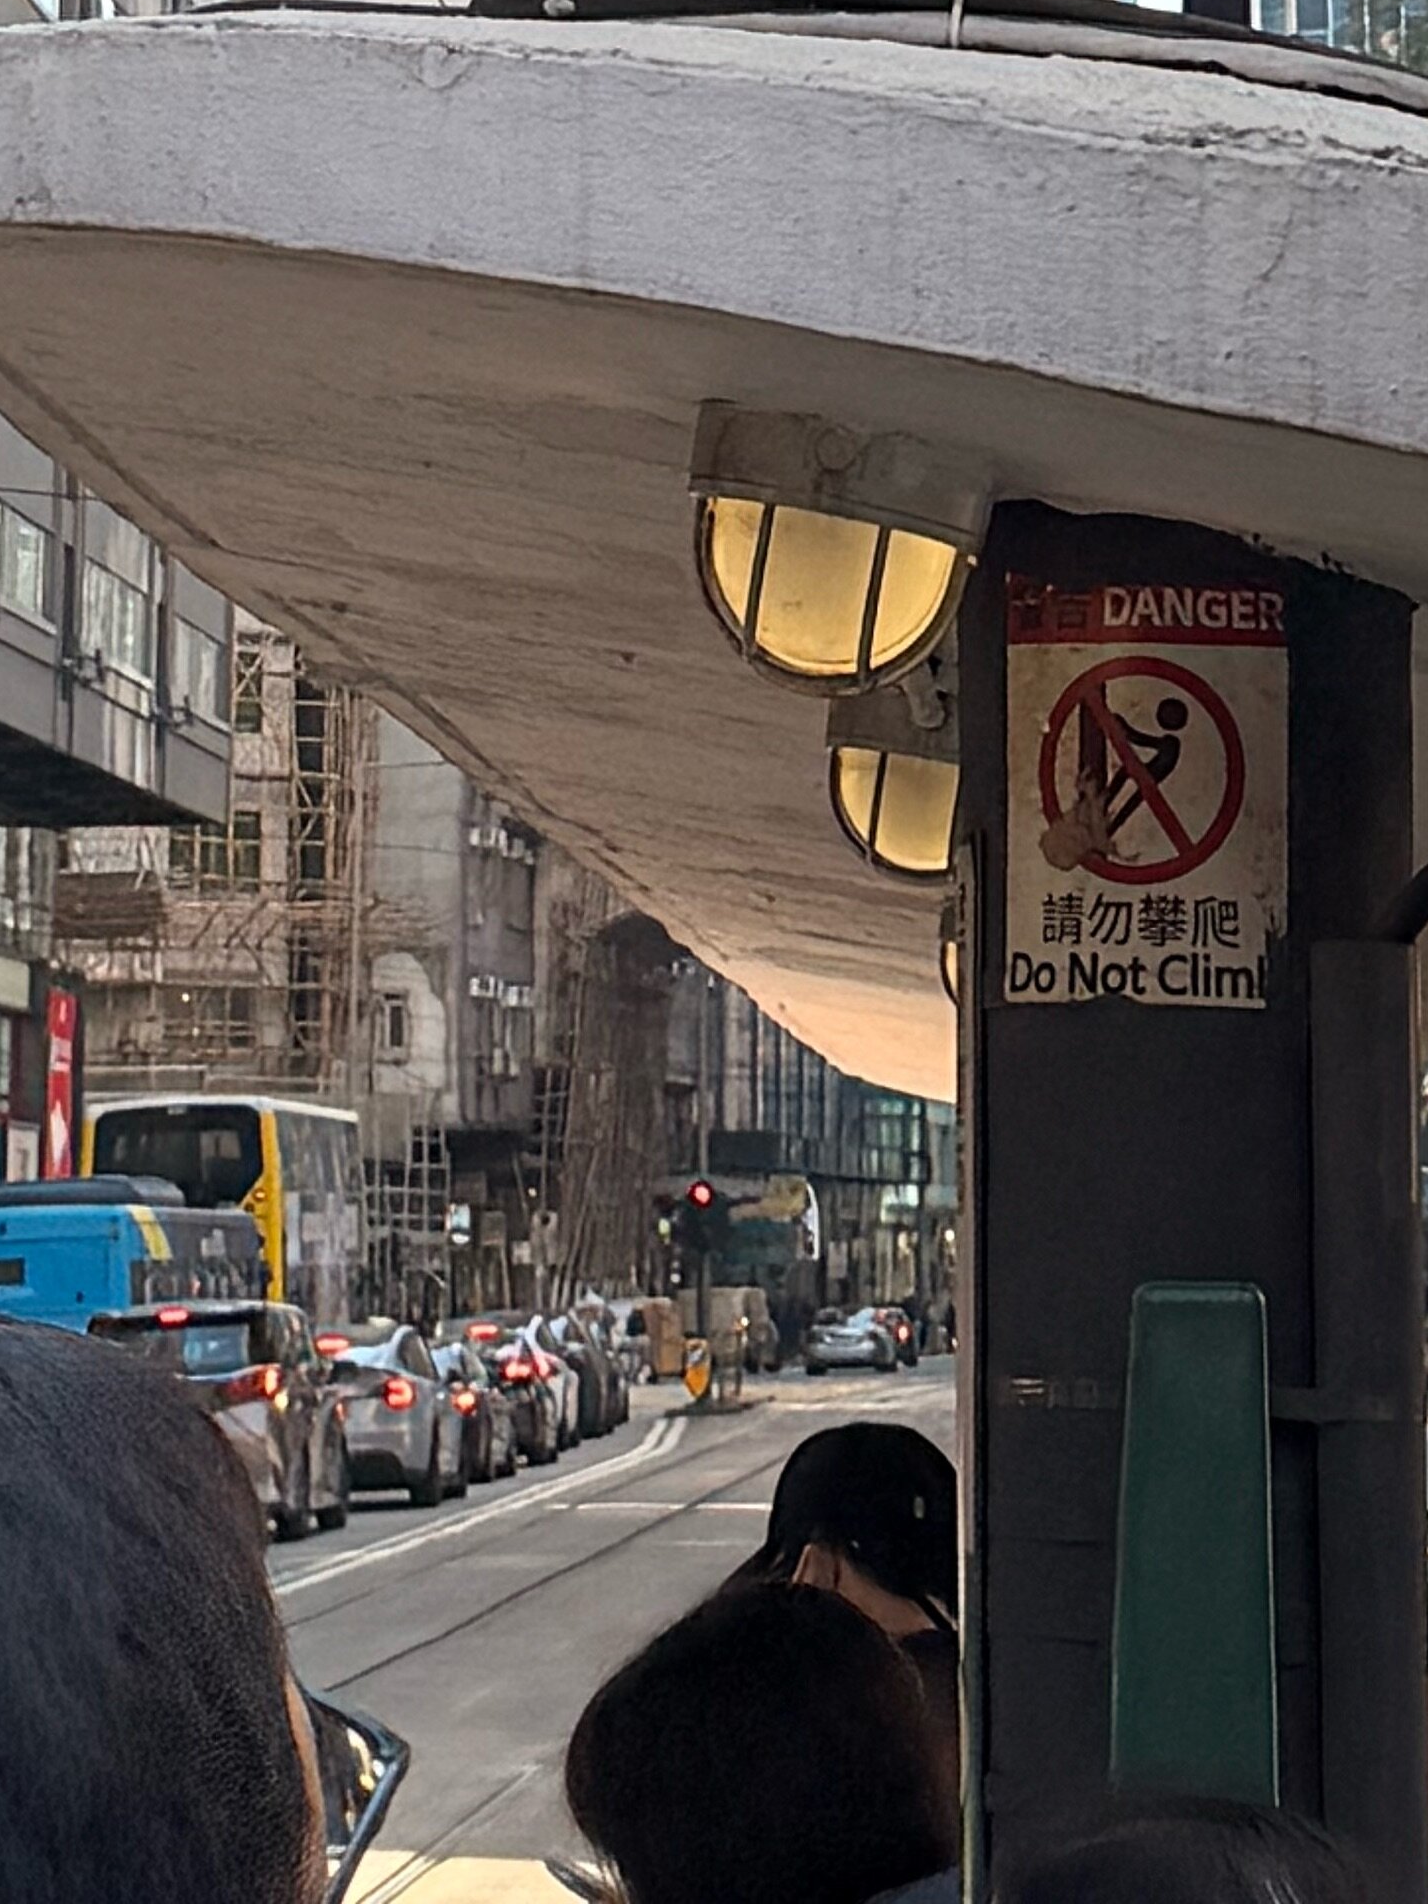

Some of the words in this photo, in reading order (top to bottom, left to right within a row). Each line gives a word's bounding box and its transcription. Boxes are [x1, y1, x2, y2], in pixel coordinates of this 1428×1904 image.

[1102, 586, 1284, 631] DANGER
[1041, 893, 1241, 950] 請勿攀爬
[1009, 951, 1057, 994] Do
[1068, 951, 1148, 995] Not
